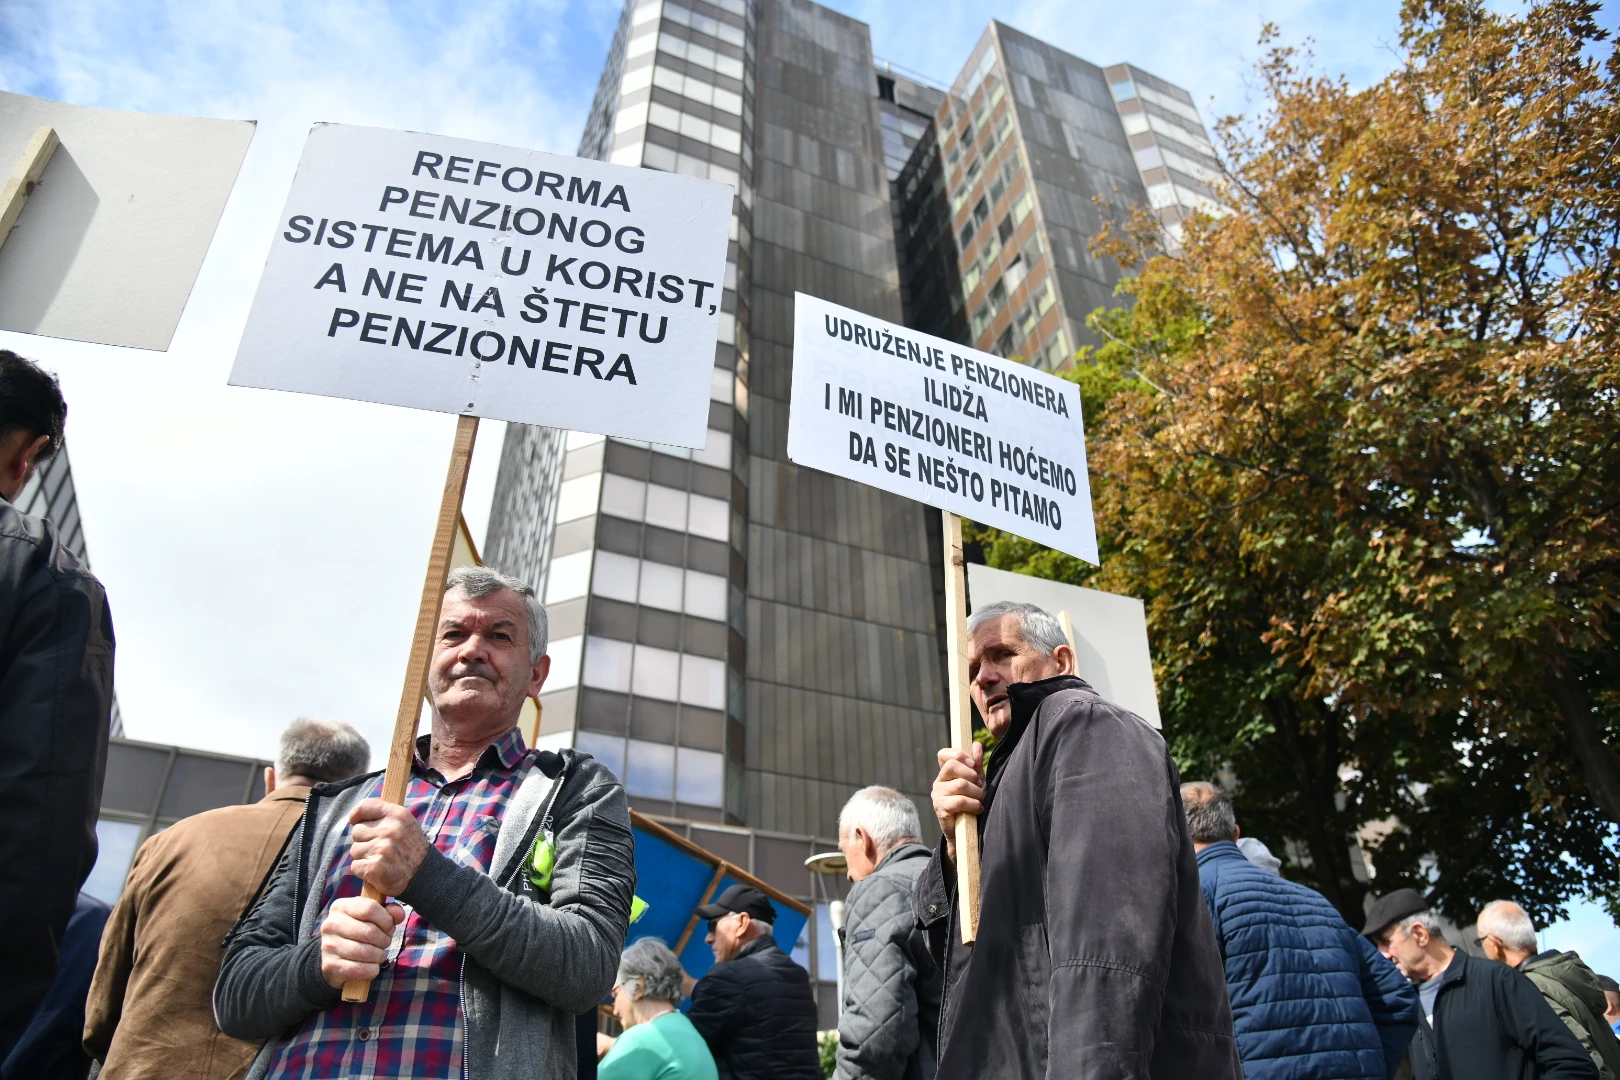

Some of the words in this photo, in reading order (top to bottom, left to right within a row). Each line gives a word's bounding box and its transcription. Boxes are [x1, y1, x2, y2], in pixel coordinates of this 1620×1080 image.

[379, 186, 645, 254] PENZIONOG
[412, 151, 630, 213] REFORMA
[284, 215, 484, 270] SISTEMA
[501, 247, 531, 276] U
[546, 254, 715, 316] KORIST,
[314, 263, 346, 293] A
[362, 268, 427, 304] NE
[440, 280, 505, 318] NA
[520, 286, 668, 344] ŠTETU
[327, 308, 637, 386] PENZIONERA
[825, 314, 946, 371] UDRUŽENJE
[951, 353, 1069, 419] PENZIONERA
[825, 383, 830, 410] I
[839, 387, 863, 420] MI
[871, 397, 993, 465] PENZIONERI
[999, 440, 1077, 497] HOĆEMO
[923, 376, 989, 423] ILIDŽA
[849, 430, 878, 468] DA
[884, 443, 911, 479] SE
[917, 453, 984, 503] NEŠTO
[990, 477, 1062, 531] PITAMO
